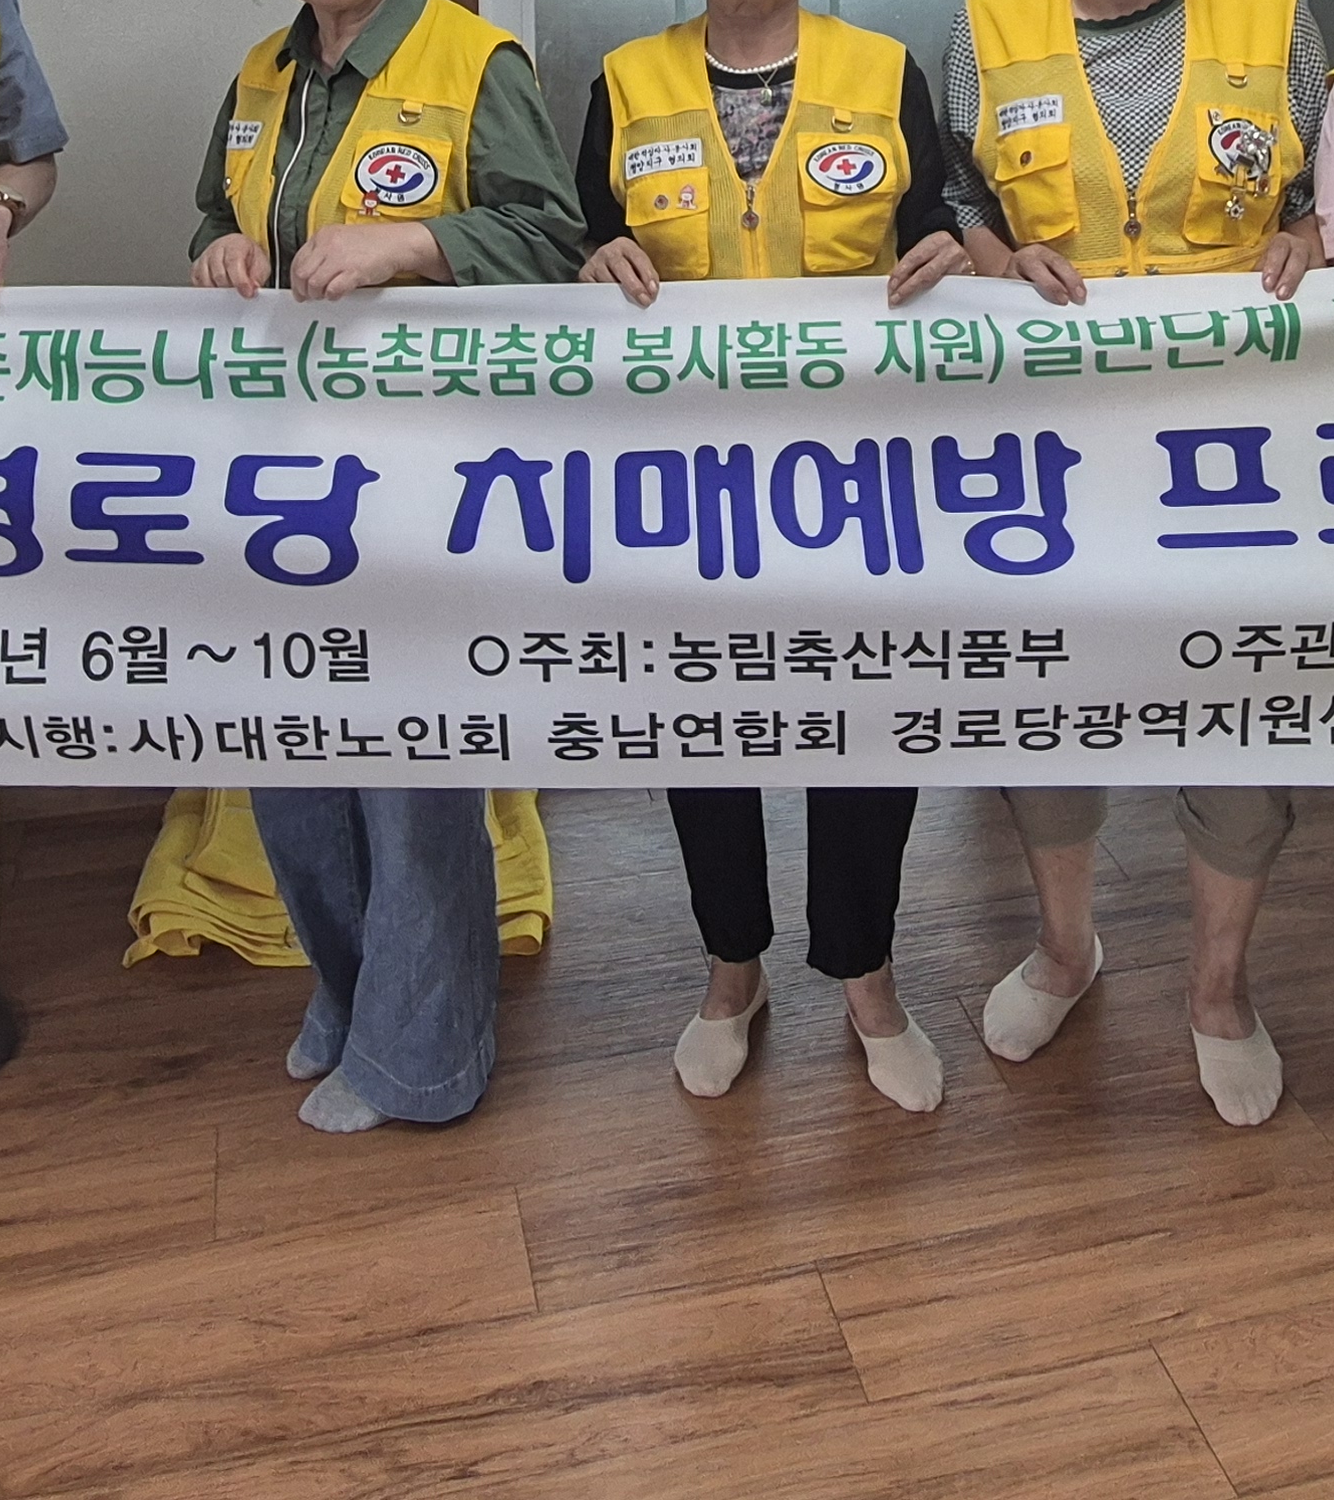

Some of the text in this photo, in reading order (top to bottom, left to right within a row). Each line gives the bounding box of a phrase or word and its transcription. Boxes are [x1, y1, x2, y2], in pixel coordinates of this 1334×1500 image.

[368, 147, 430, 170] KOREAN RED CROSS
[813, 147, 837, 162] KOREAN
[622, 320, 847, 394] 봉사활동
[446, 429, 1082, 585] 치매예방
[547, 708, 847, 761] 충남연합회
